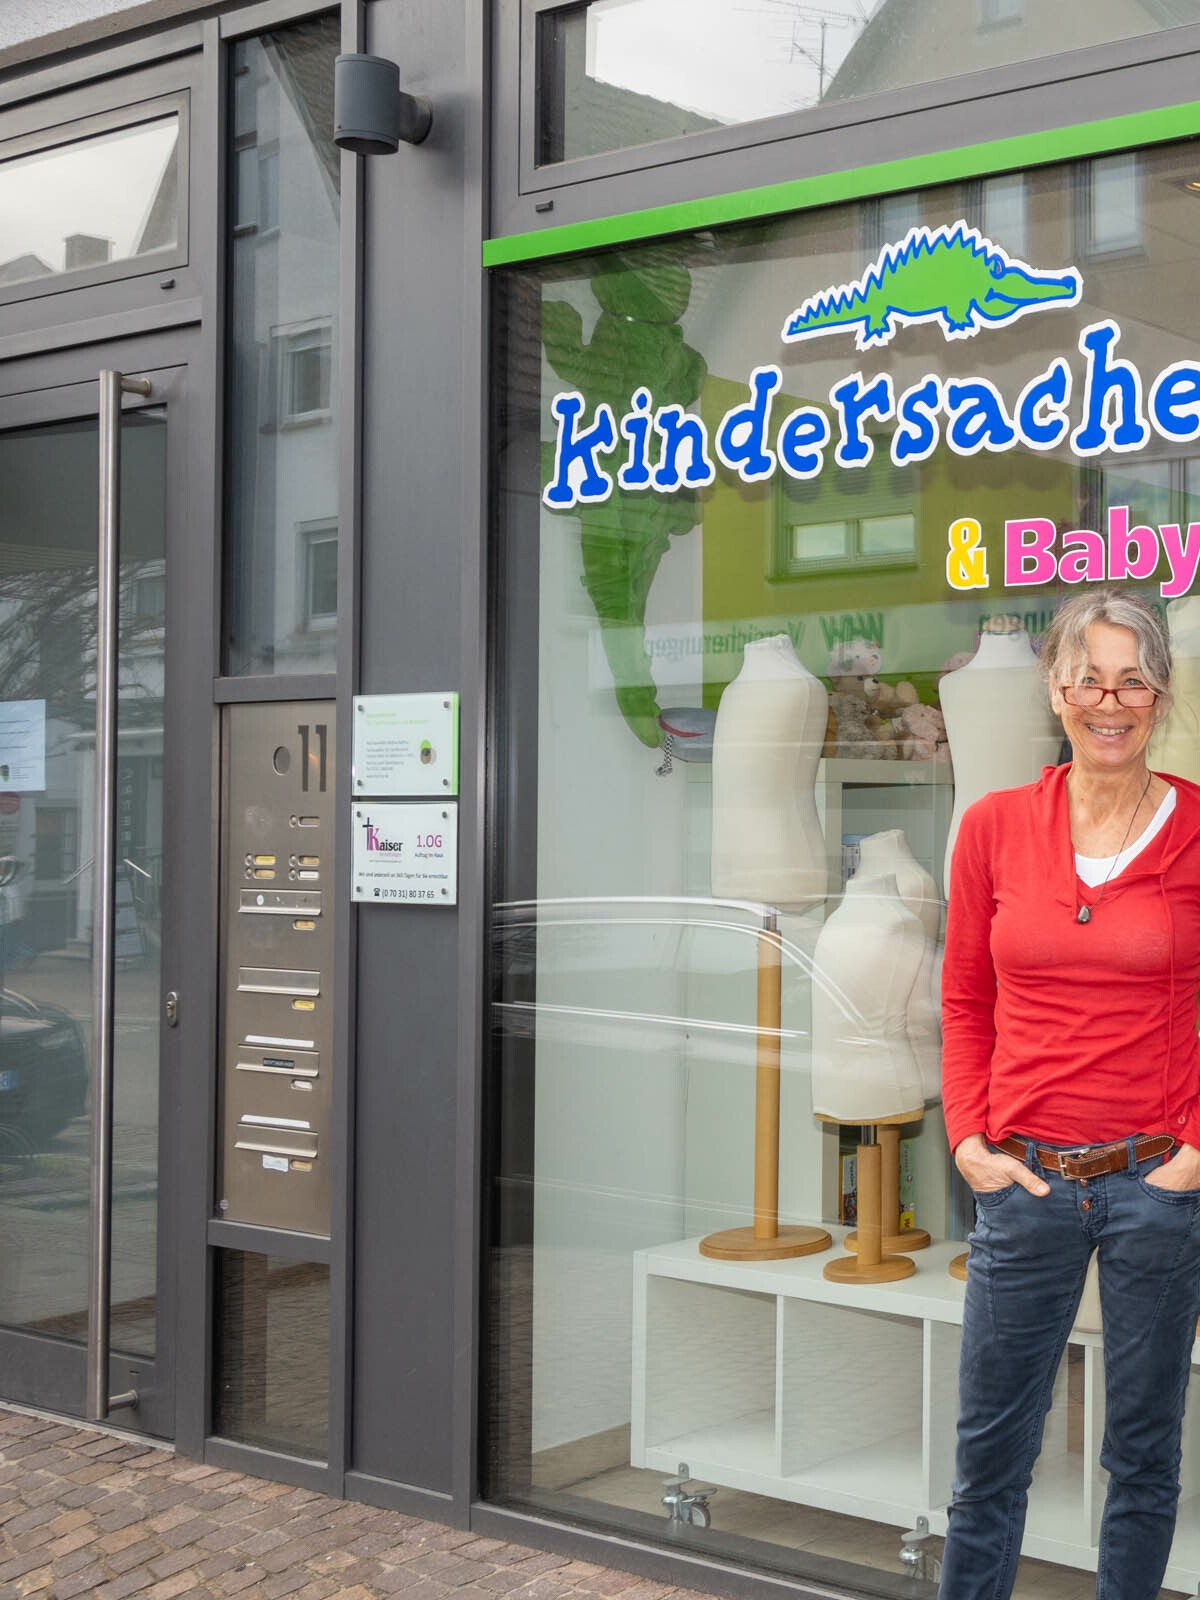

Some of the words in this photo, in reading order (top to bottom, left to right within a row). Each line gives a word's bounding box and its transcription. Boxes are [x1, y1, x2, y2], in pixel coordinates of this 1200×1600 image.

[946, 517, 988, 590] &
[298, 724, 327, 793] 11
[367, 826, 403, 851] Kaiser
[416, 834, 443, 848] 1.OG
[398, 890, 407, 899] 31)
